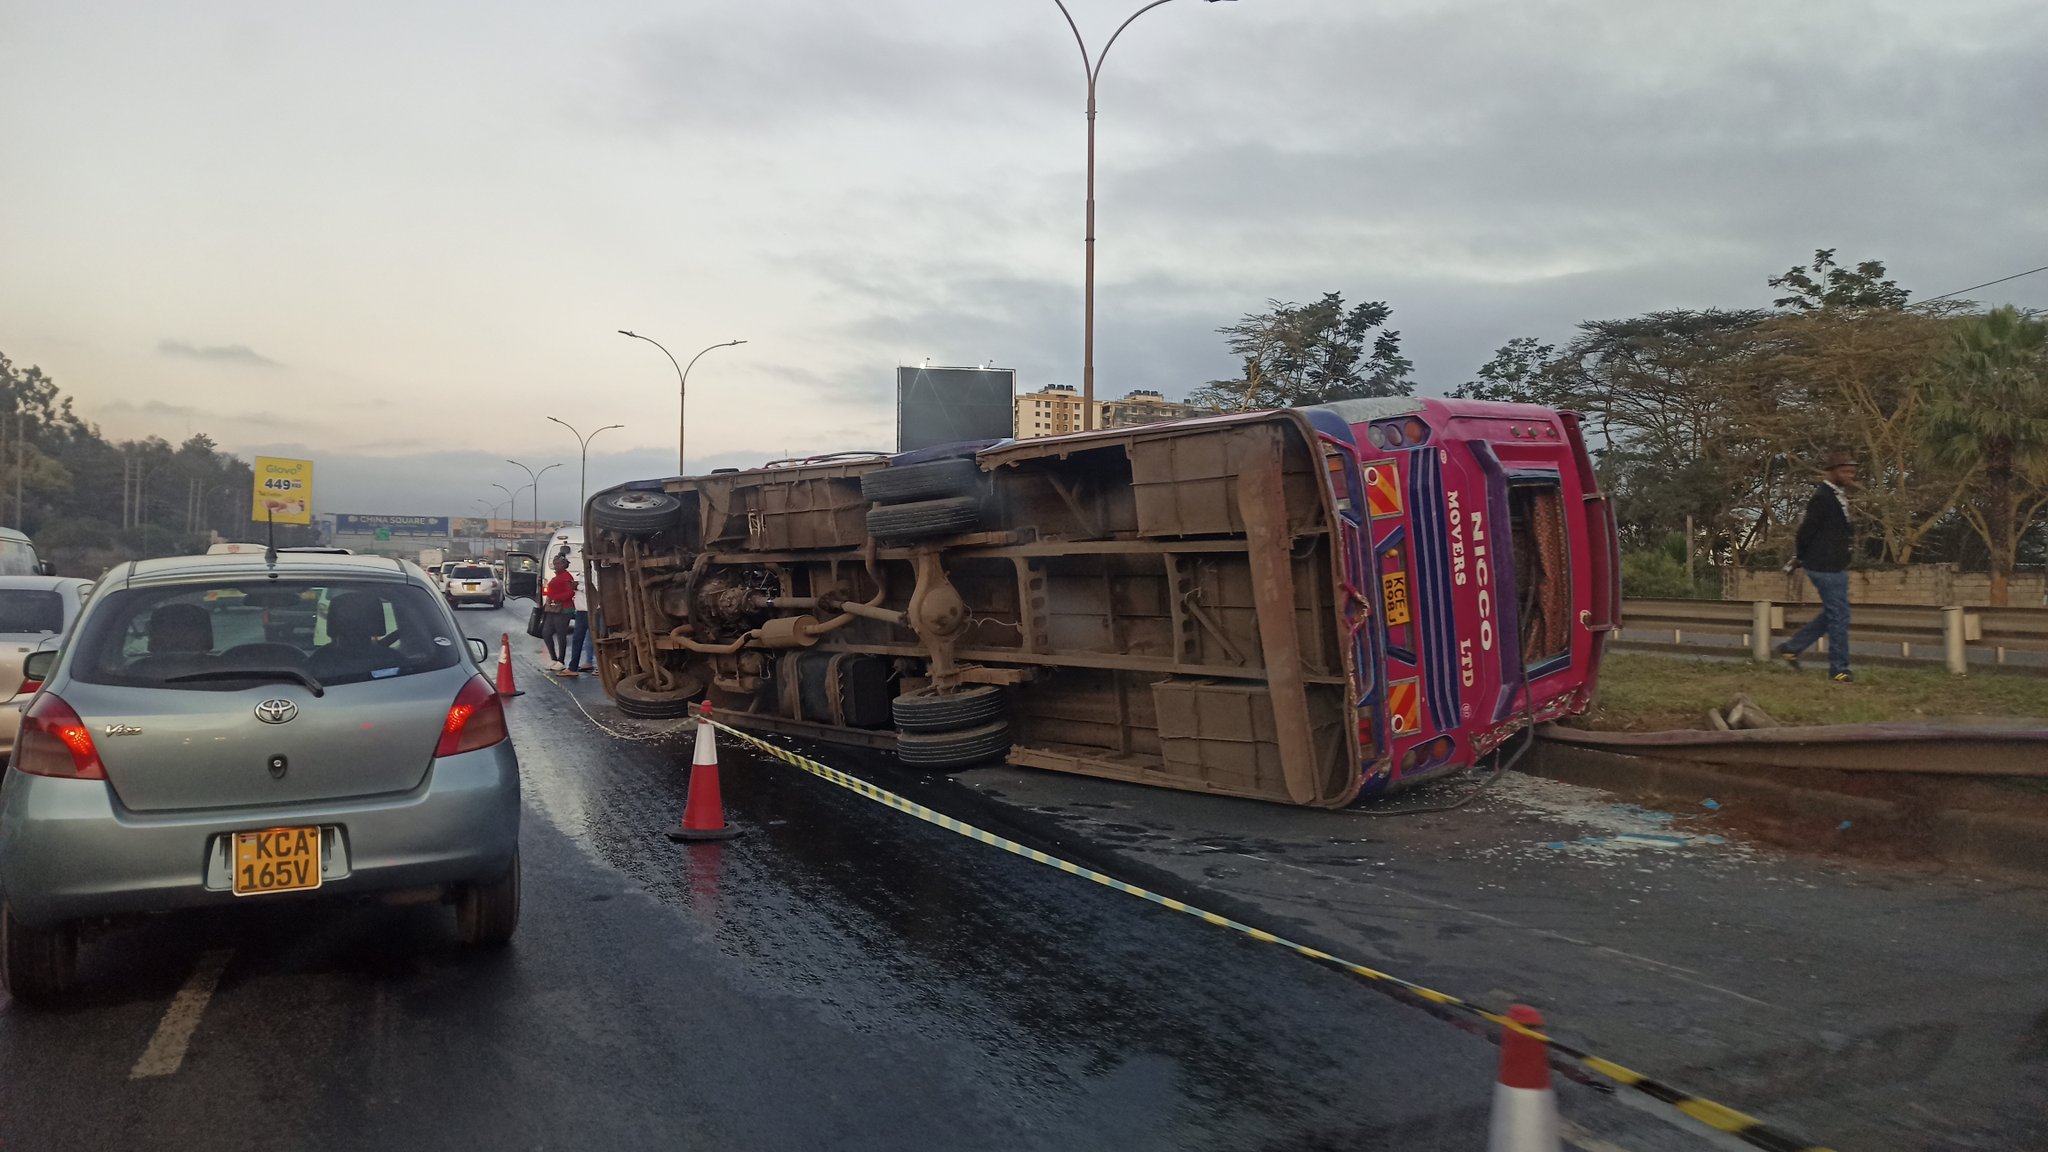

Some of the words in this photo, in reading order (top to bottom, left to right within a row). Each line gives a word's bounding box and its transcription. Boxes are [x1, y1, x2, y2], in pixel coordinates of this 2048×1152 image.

[265, 478, 291, 490] 449
[360, 515, 388, 524] CHINA
[389, 517, 425, 525] SQUARE
[1447, 490, 1467, 586] MOVERS
[1460, 638, 1473, 688] LTD
[1471, 511, 1492, 651] NICCO
[256, 829, 310, 859] KCA
[240, 859, 310, 890] 165V
